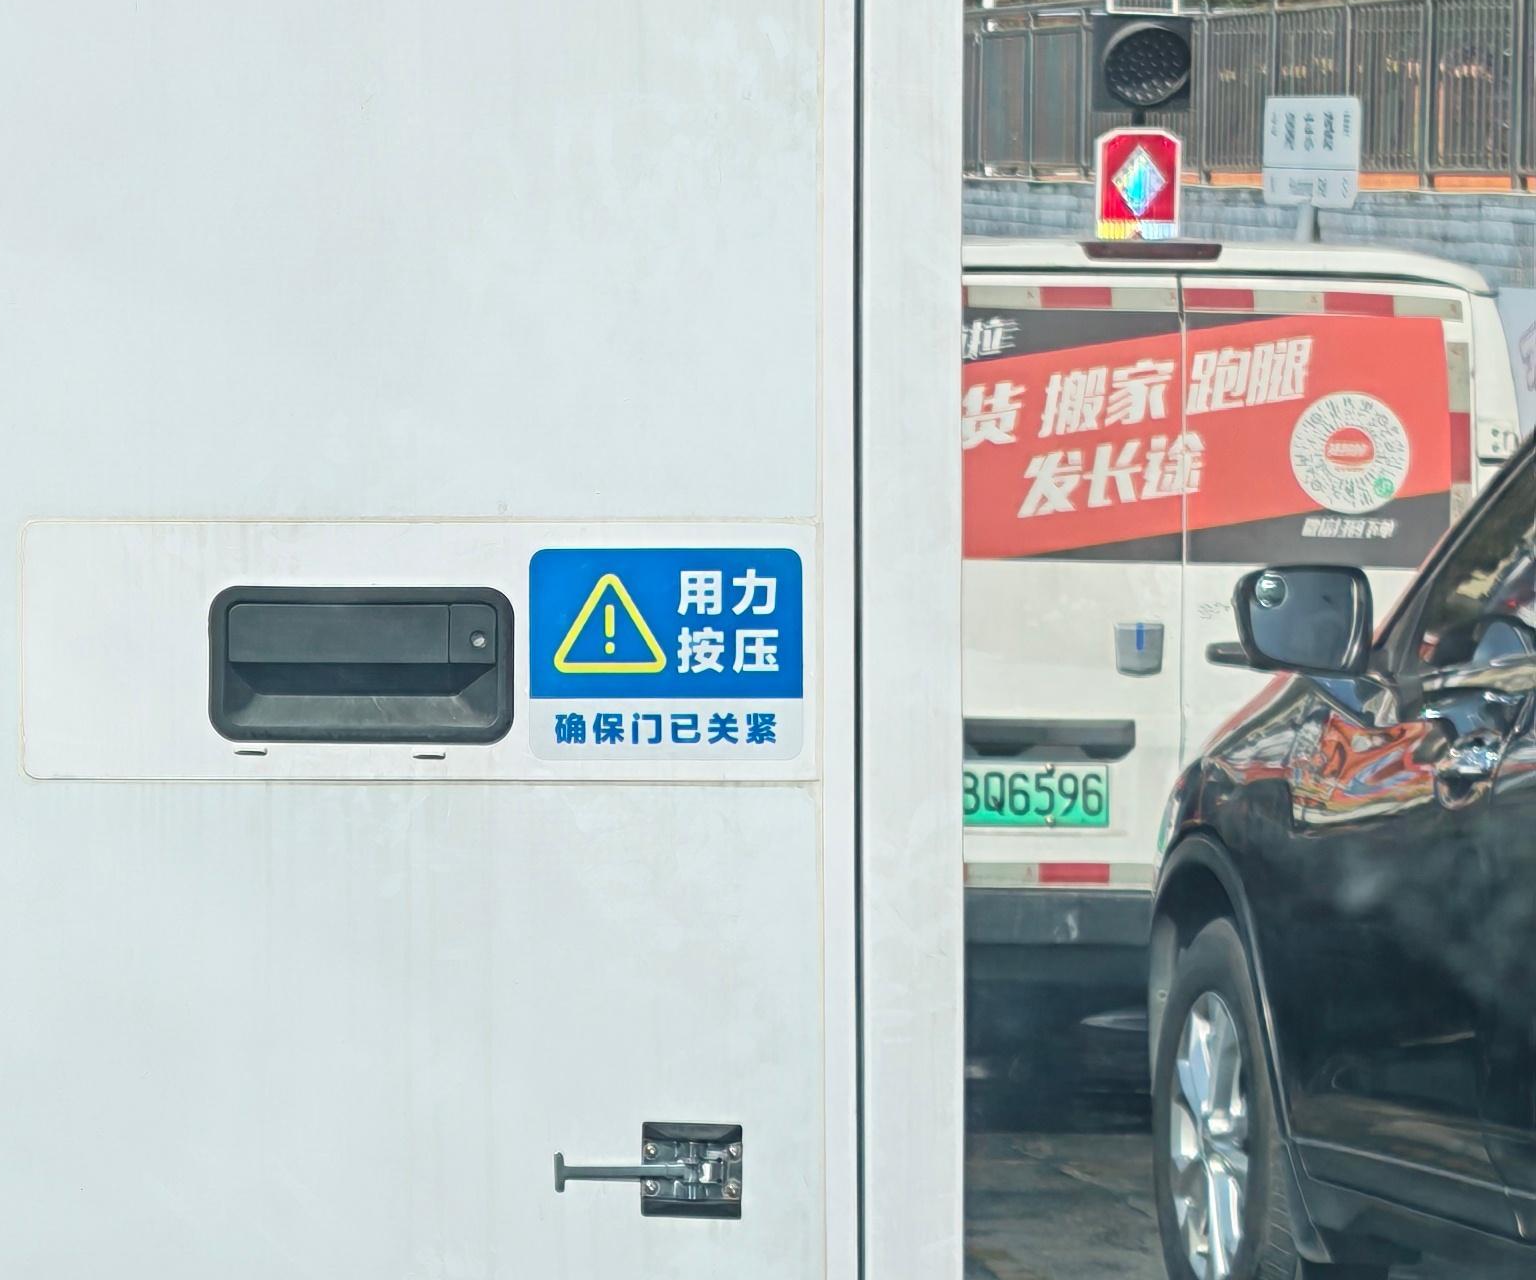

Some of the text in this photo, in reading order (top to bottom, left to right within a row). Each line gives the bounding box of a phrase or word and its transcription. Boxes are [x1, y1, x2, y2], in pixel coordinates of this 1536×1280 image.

[962, 317, 1021, 360] 拉
[1037, 359, 1175, 438] 搬家
[1186, 336, 1314, 415] 跑腿
[1016, 432, 1205, 518] 发长途
[677, 569, 777, 616] 用力
[677, 626, 779, 674] 按压
[554, 712, 778, 745] 确保门已关紧
